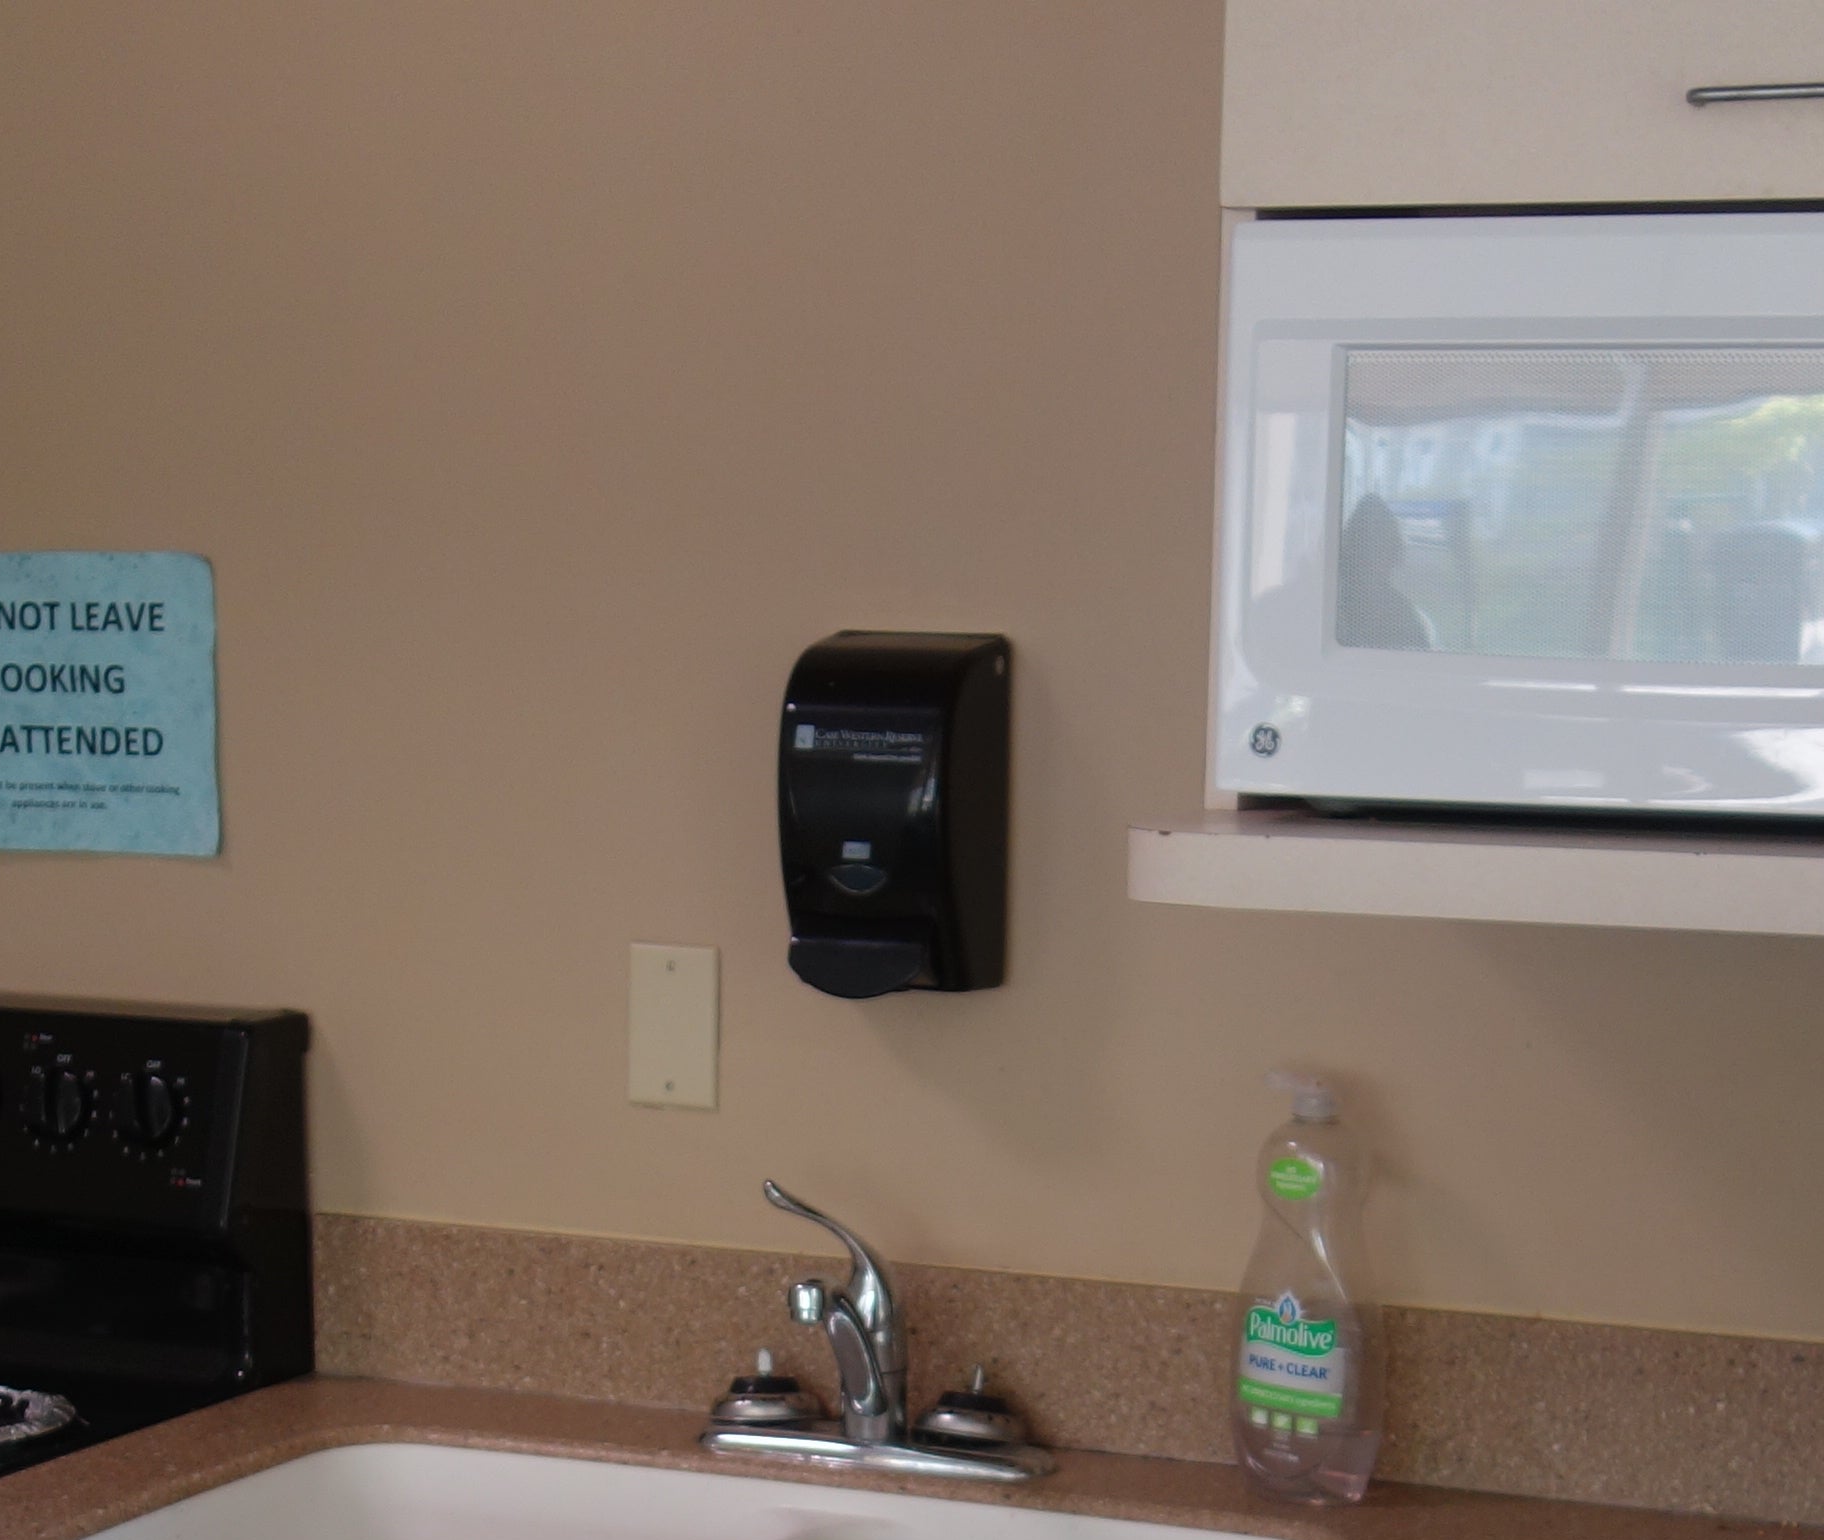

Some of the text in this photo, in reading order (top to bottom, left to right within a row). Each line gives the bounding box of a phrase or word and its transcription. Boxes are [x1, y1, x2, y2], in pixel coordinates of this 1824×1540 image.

[71, 602, 164, 632] LEAVE
[1249, 1311, 1332, 1349] Palmolive
[1249, 1354, 1275, 1371] PURE
[1287, 1362, 1328, 1379] CLEAR
